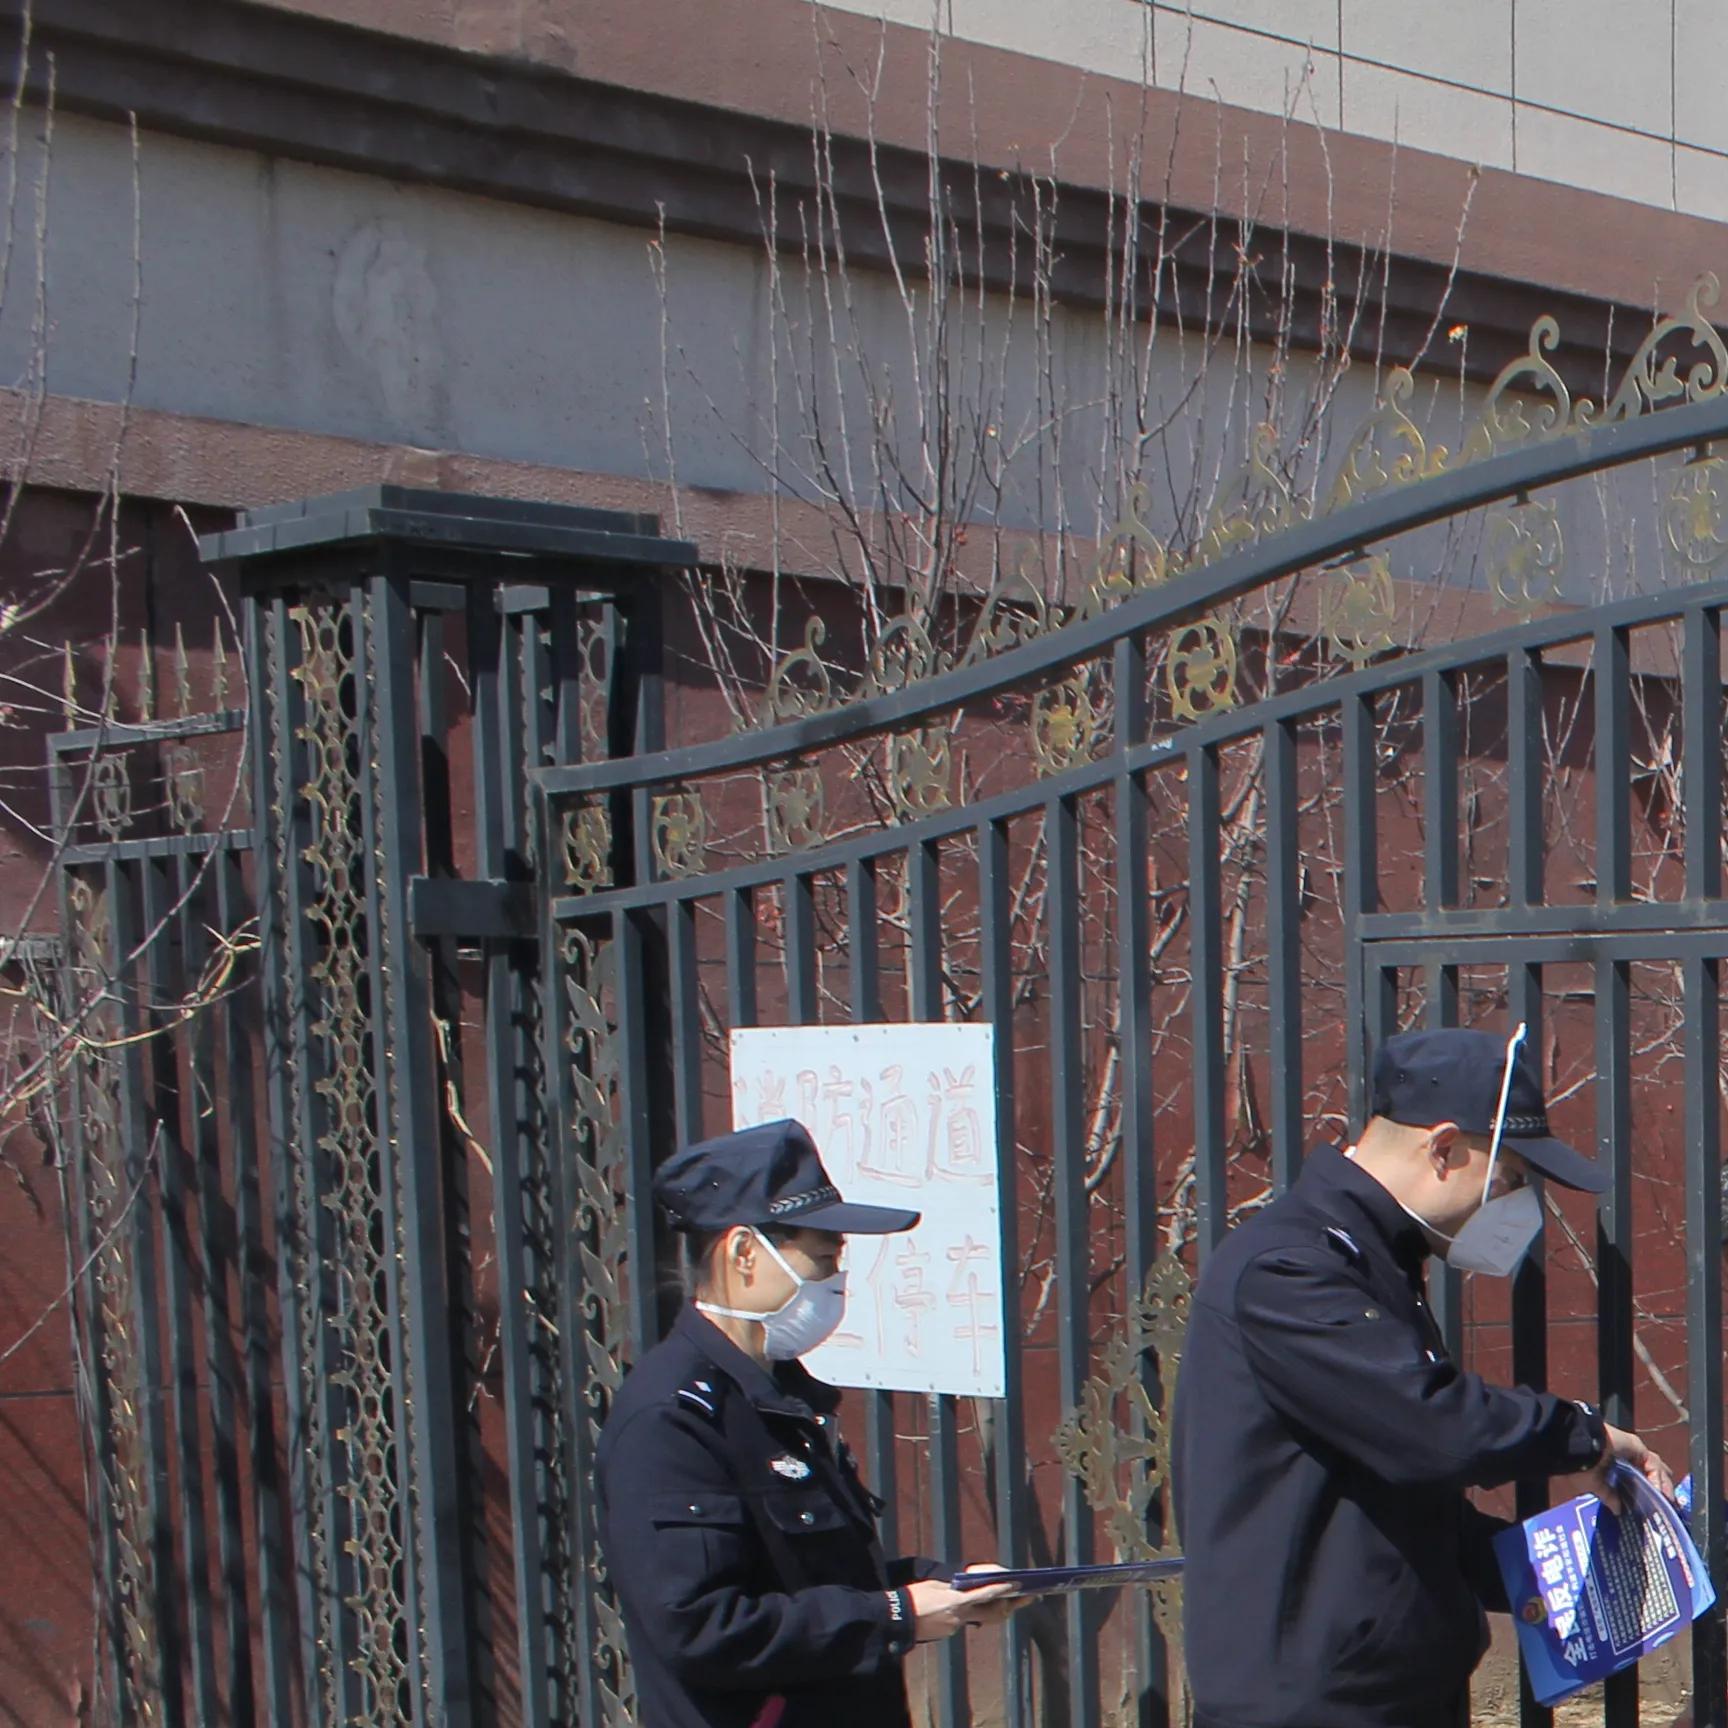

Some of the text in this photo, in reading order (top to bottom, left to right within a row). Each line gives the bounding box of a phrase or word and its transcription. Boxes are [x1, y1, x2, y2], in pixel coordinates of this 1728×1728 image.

[1533, 1526, 1588, 1667] 全民反电诈
